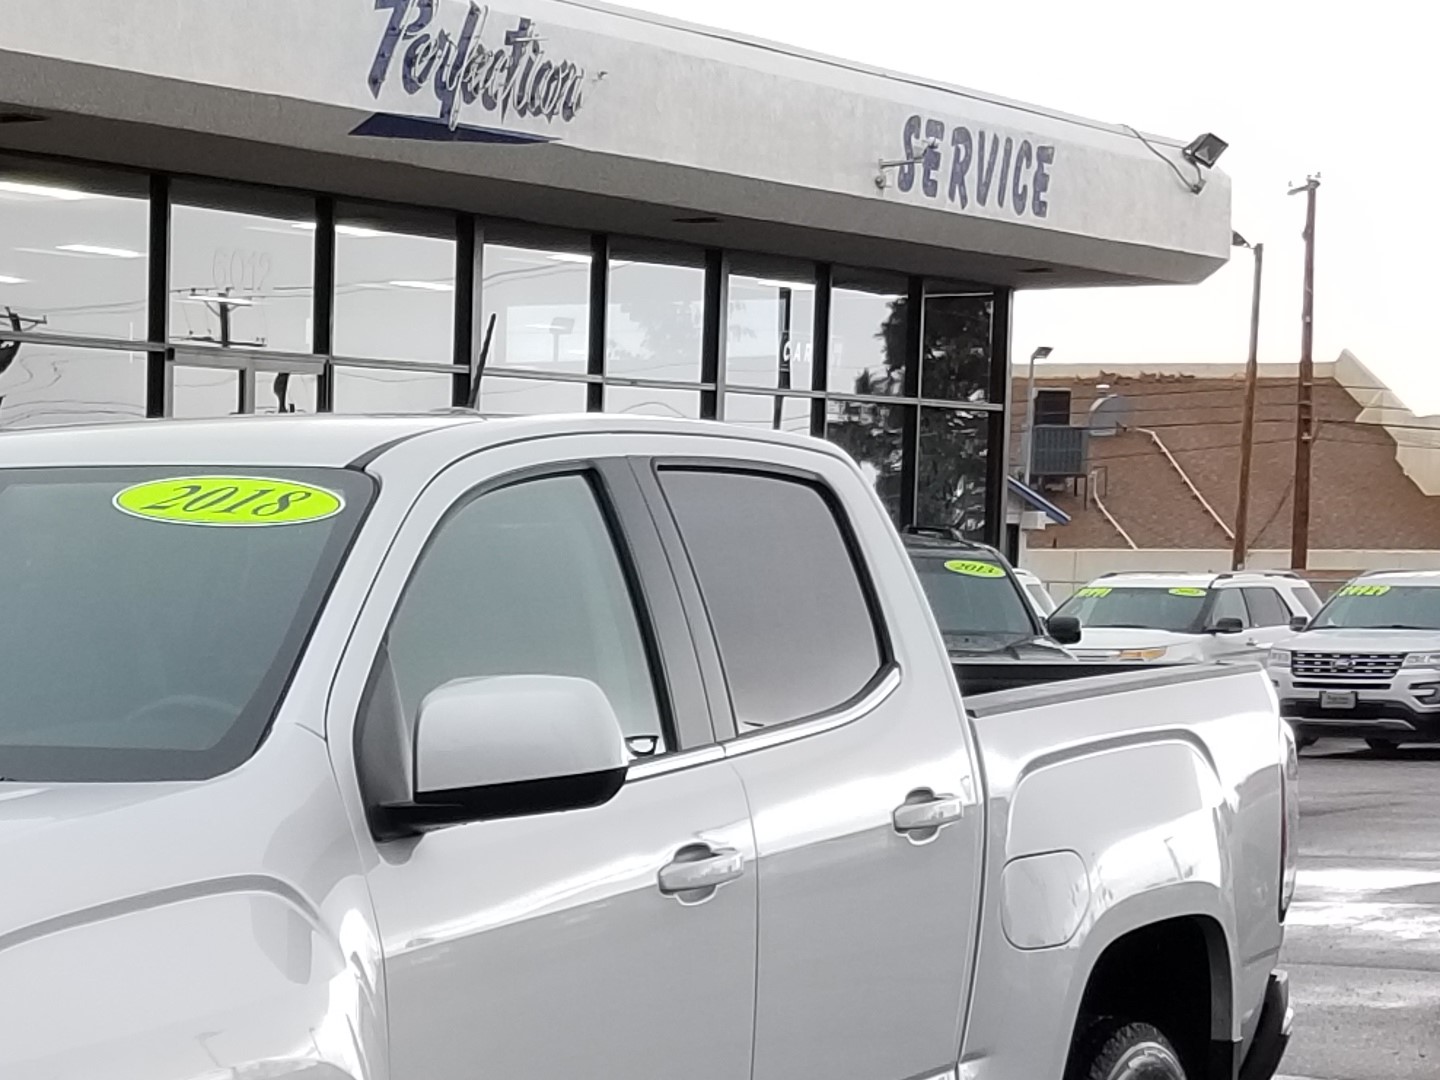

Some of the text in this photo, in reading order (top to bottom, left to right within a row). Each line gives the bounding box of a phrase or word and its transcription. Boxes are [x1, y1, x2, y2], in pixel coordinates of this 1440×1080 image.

[367, 0, 584, 131] Perfection
[897, 114, 1055, 218] SERVICE
[139, 484, 312, 517] 2018
